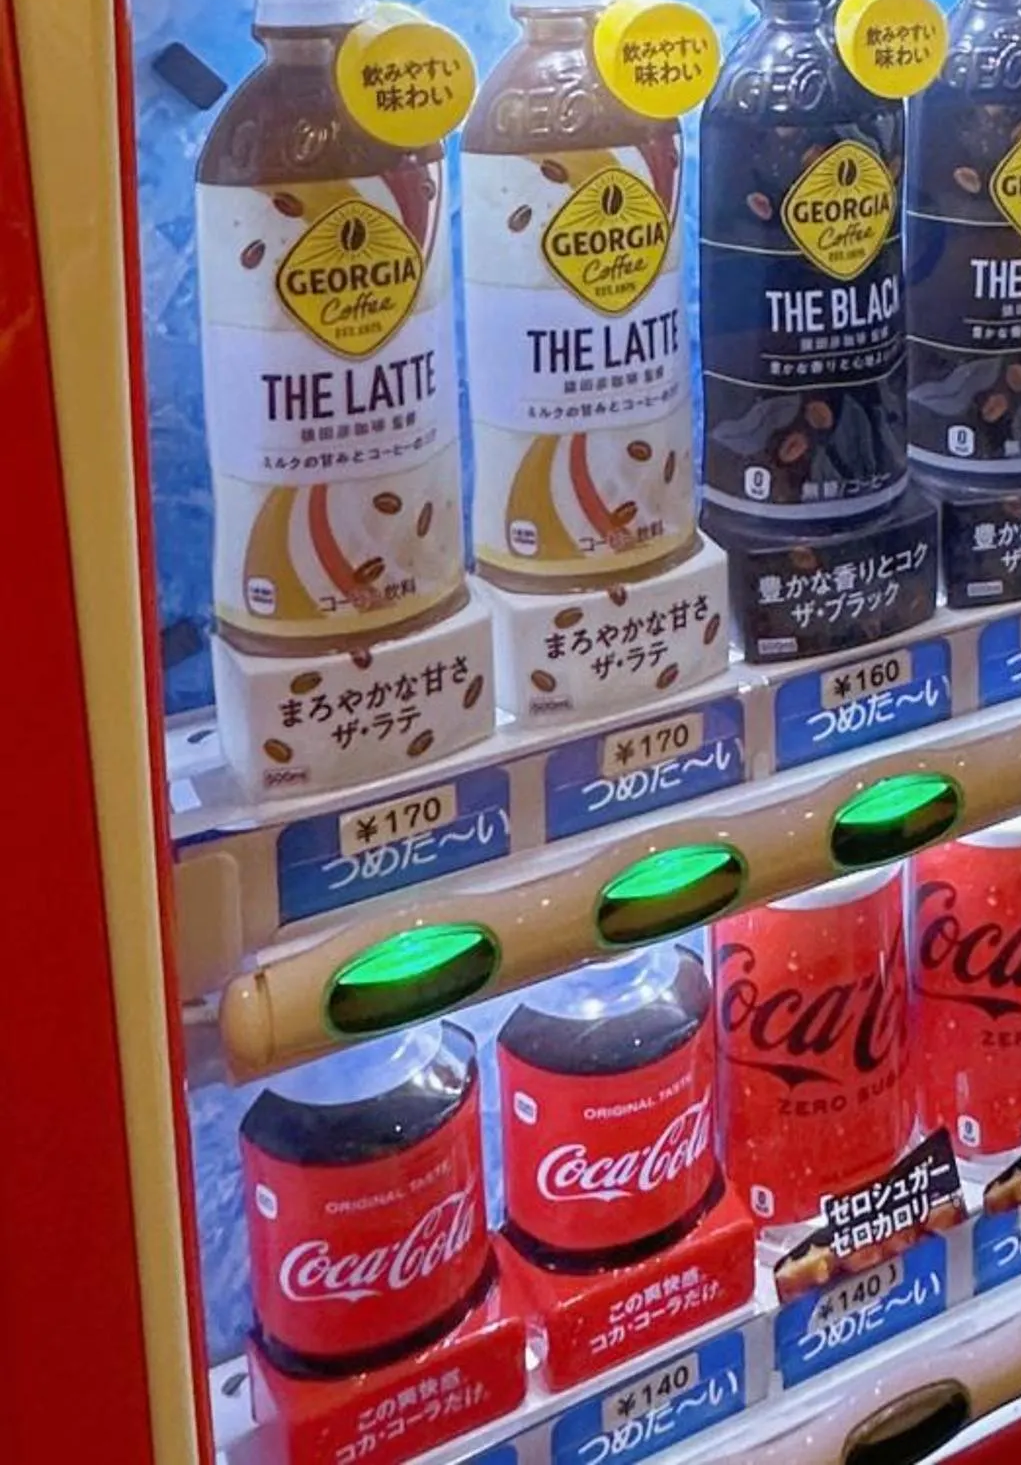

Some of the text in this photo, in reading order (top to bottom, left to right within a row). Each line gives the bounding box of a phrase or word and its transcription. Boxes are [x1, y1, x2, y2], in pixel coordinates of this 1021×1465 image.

[621, 36, 709, 64] 飲みやすい
[865, 24, 937, 47] 飲みやすい
[361, 57, 461, 88] 飲みやすい
[634, 62, 702, 88] 味わい
[875, 46, 931, 70] 味わい
[375, 85, 453, 113] 味わい
[792, 191, 891, 225] GEORGIA
[551, 218, 666, 259] GEORGIA
[817, 221, 873, 253] Coffee
[285, 255, 419, 298] GEORGIA
[581, 255, 649, 286] Coffee
[319, 285, 398, 327] Coffee
[765, 289, 825, 333] THE
[526, 308, 679, 374] THE LATTE
[261, 349, 437, 421] THE LATTE
[757, 541, 930, 605] 豊かな香りとコク
[543, 594, 708, 661] まろやかな甘さ
[791, 584, 900, 628] ザ・ブラック
[589, 640, 670, 682] ザ・ラテ
[833, 658, 900, 698] ¥160
[278, 654, 470, 728] まろやかな甘さ
[331, 703, 421, 751] ザ・ラテ
[614, 721, 690, 766] ¥170
[355, 796, 442, 844] ¥170
[583, 1098, 656, 1122] ORIGINAL
[776, 1094, 849, 1118] ZERO
[537, 1088, 713, 1203] Coca-Cola
[324, 1188, 406, 1215] ORIGINAL
[829, 1155, 951, 1228] ゼロシュガー
[278, 1172, 477, 1302] Coca-Cola
[829, 1194, 951, 1259] ゼロカロリー
[817, 1273, 882, 1321] ¥140
[617, 1364, 691, 1419] ¥140
